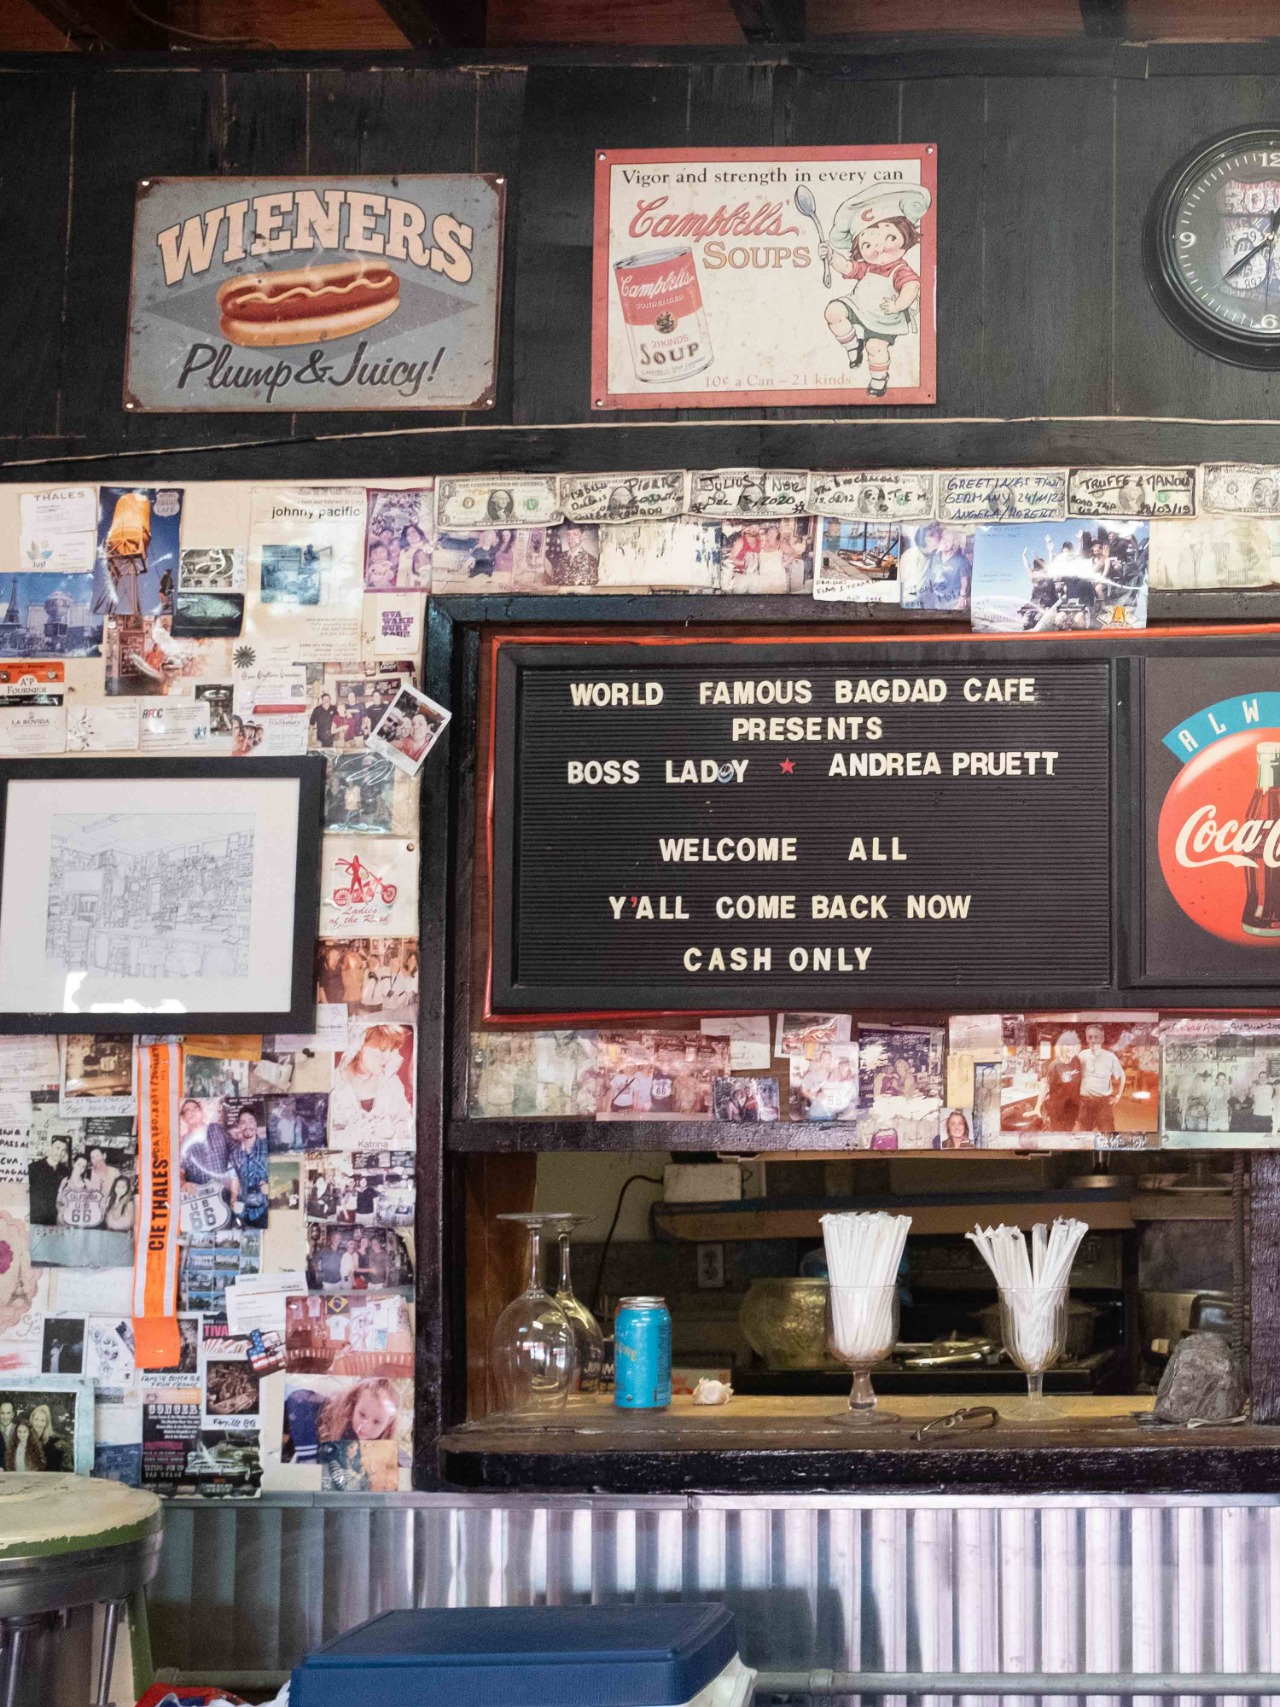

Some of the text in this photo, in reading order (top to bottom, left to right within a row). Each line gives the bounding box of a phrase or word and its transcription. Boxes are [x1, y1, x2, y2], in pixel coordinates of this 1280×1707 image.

[622, 168, 904, 187] Vigor and strength in every can
[156, 189, 474, 287] WIENERS
[1179, 231, 1197, 249] 9
[702, 241, 812, 269] SOUPS
[1261, 314, 1279, 329] 6
[640, 342, 699, 365] SOUP
[178, 341, 446, 403] Plump & Juicy!
[735, 379, 742, 387] a
[746, 374, 774, 386] Can
[792, 374, 808, 386] 21
[815, 373, 851, 386] kinds
[34, 491, 86, 502] THALES
[944, 491, 1016, 505] GERMANY
[272, 506, 360, 519] johnny pacific
[570, 677, 1036, 707] WORLD FAMOUS BAGDAD CAFE
[732, 716, 883, 742] PRESENTS
[567, 759, 641, 785] BOSS
[828, 751, 942, 777] ANDREA
[952, 750, 1059, 777] PRUETT
[659, 837, 907, 863] WELCOME ALL
[364, 914, 390, 923] Rad
[609, 894, 972, 921] Y'ALL COME BACK NOW
[683, 946, 872, 972] CASH ONLY
[358, 1140, 389, 1148] Katrina
[151, 1159, 169, 1220] THALES
[71, 1209, 92, 1223] 66
[189, 1207, 217, 1232] 66
[149, 1225, 168, 1251] CIE
[149, 1404, 200, 1415] CONCER
